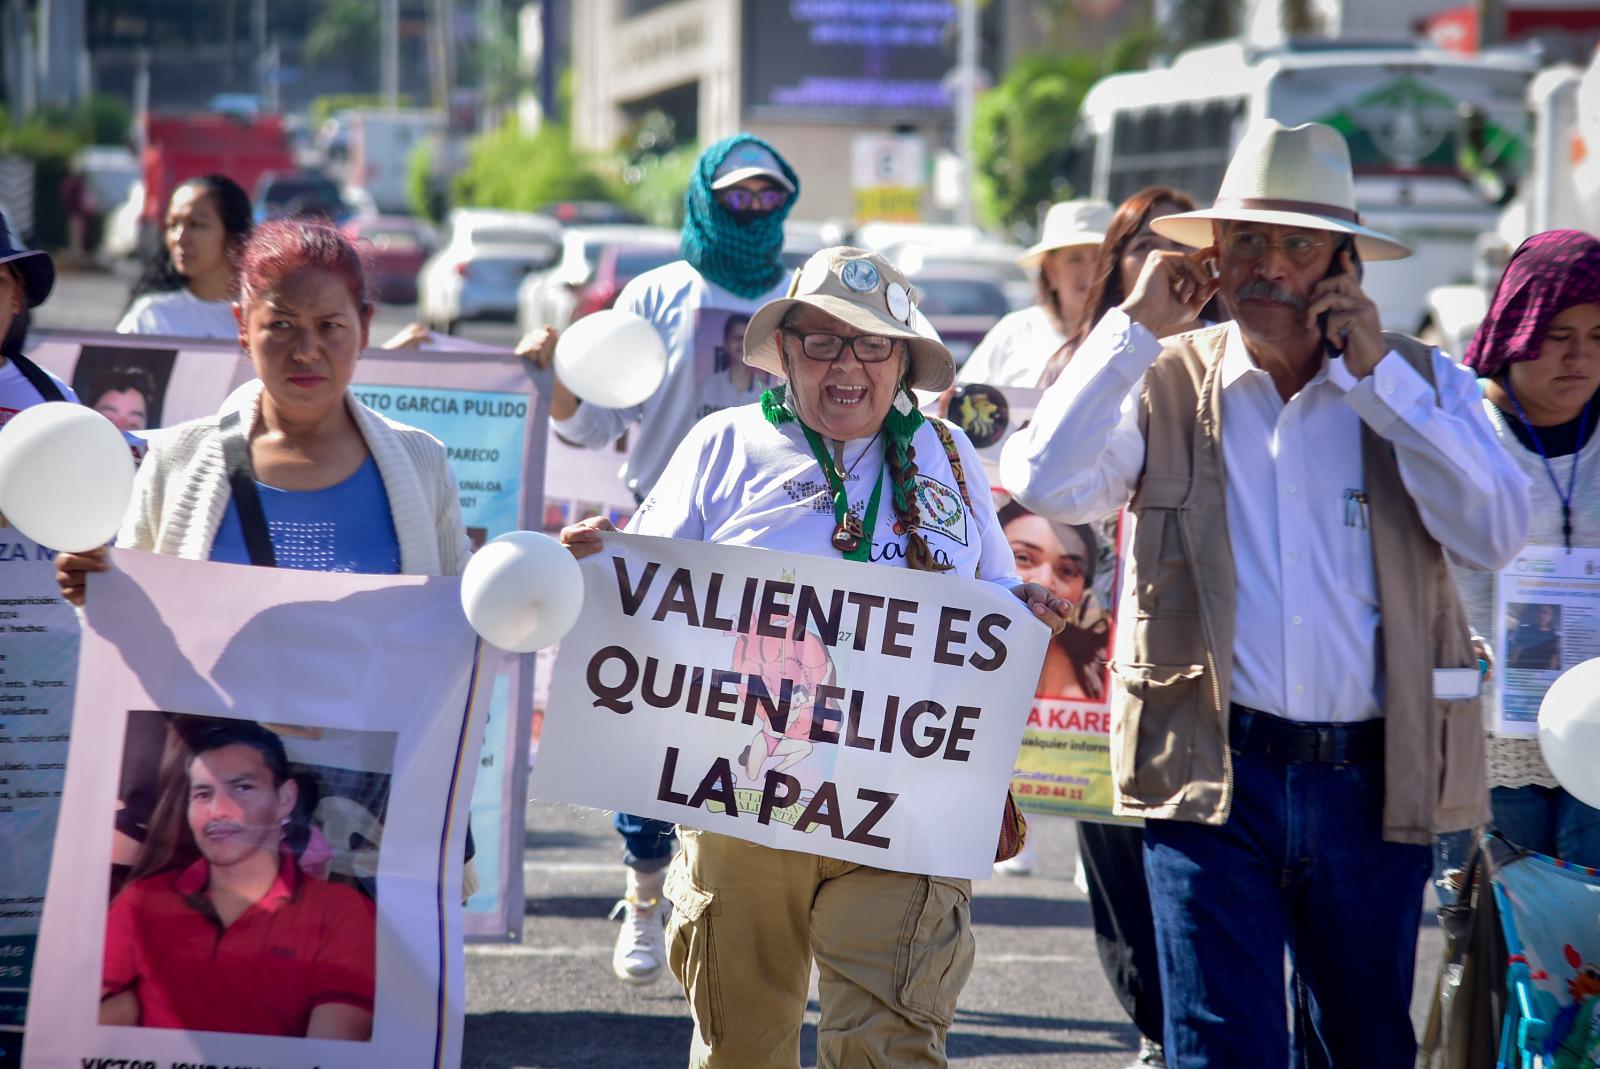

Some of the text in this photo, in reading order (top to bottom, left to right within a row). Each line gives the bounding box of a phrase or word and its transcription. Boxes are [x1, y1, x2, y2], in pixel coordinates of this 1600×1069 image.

[396, 396, 459, 416] GARCIA
[464, 399, 527, 418] PULIDO
[459, 480, 503, 492] SINALOA
[612, 555, 1013, 673] VALIENTE ES
[838, 631, 853, 641] 27
[586, 645, 982, 762] QUIEN ELIGE
[656, 746, 899, 850] LA PAZ
